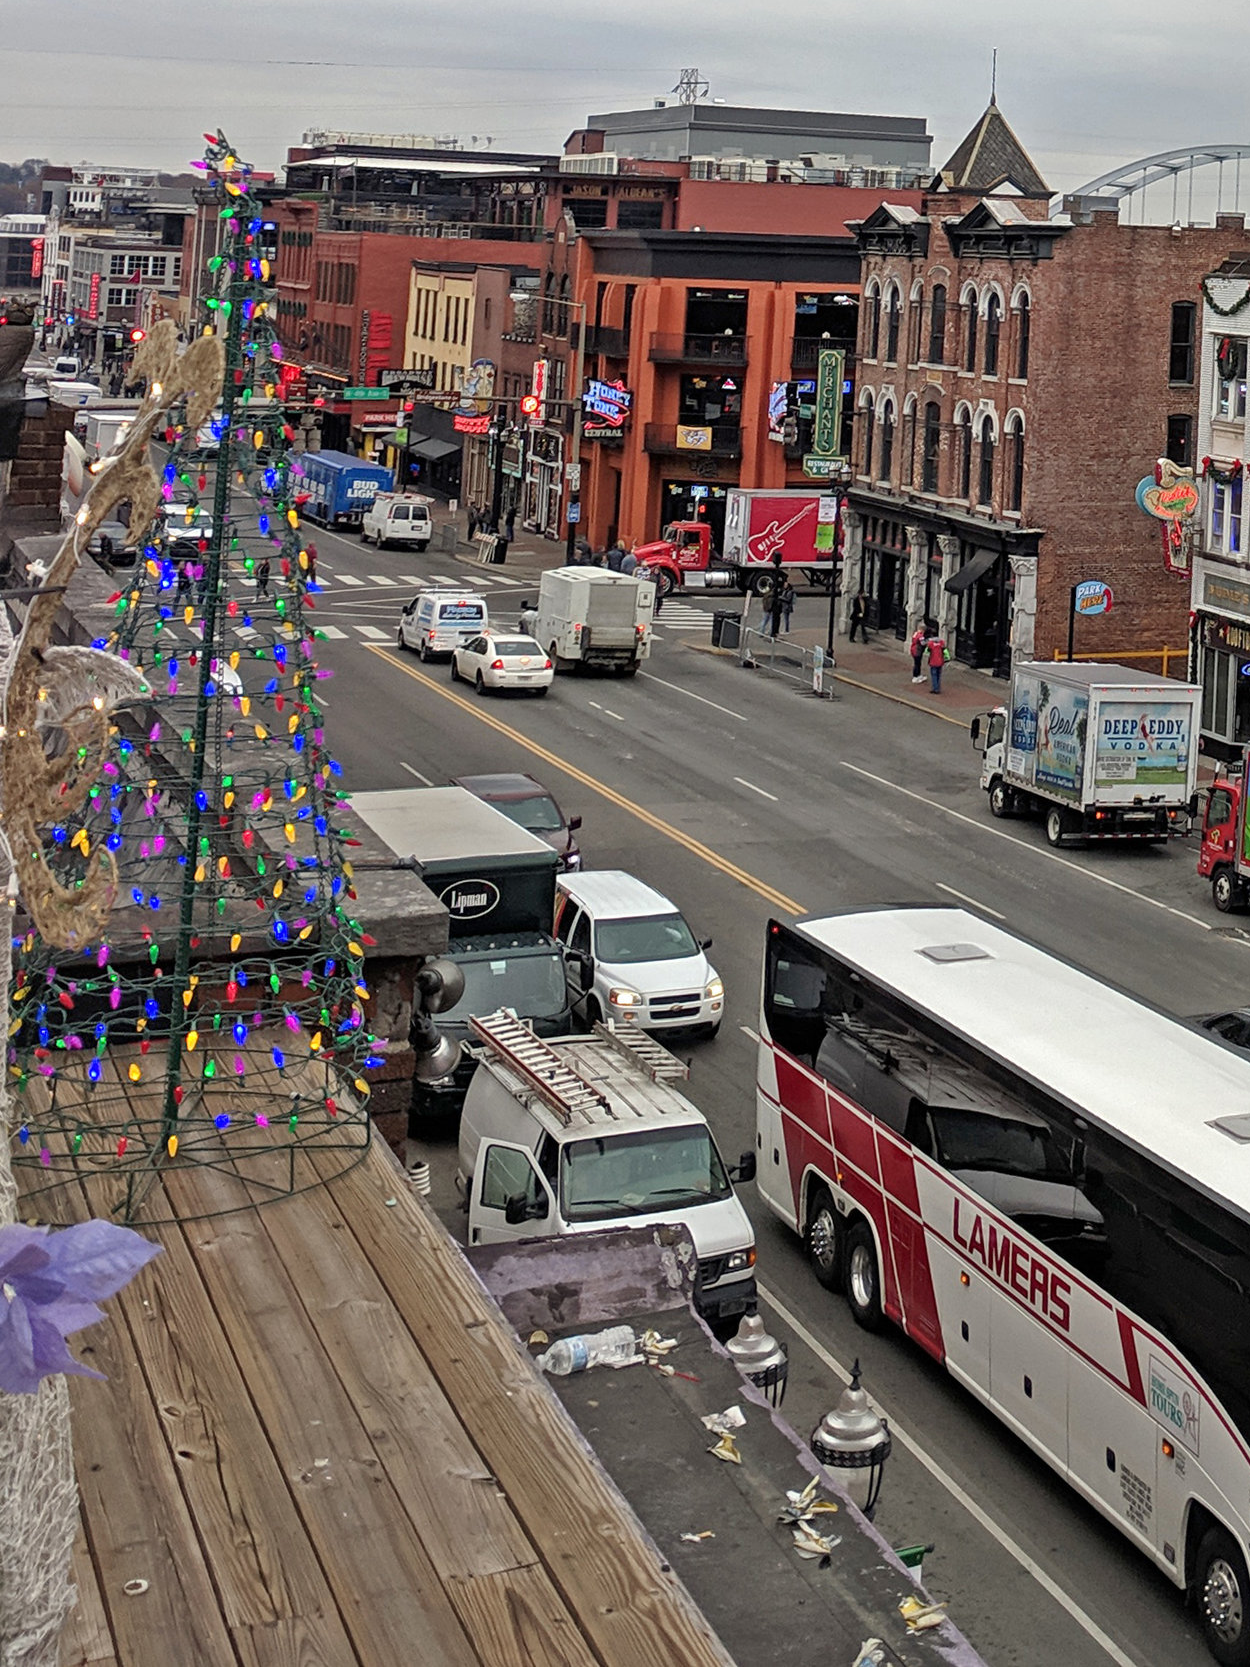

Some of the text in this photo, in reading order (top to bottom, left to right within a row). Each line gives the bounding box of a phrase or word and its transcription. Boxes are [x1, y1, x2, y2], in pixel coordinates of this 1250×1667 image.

[588, 379, 631, 406] HONKY
[583, 394, 619, 419] TONK
[821, 356, 836, 451] MERCHANTS
[585, 429, 623, 437] CENTRAL
[353, 480, 379, 489] BUD
[1077, 584, 1102, 599] PARK
[1080, 595, 1104, 610] HERE
[1104, 719, 1184, 735] DEEP EDDY
[1110, 742, 1176, 750] VODKA
[451, 890, 487, 914] Lipman
[952, 1197, 1071, 1332] LAMERS
[1151, 1387, 1183, 1429] TOURS
